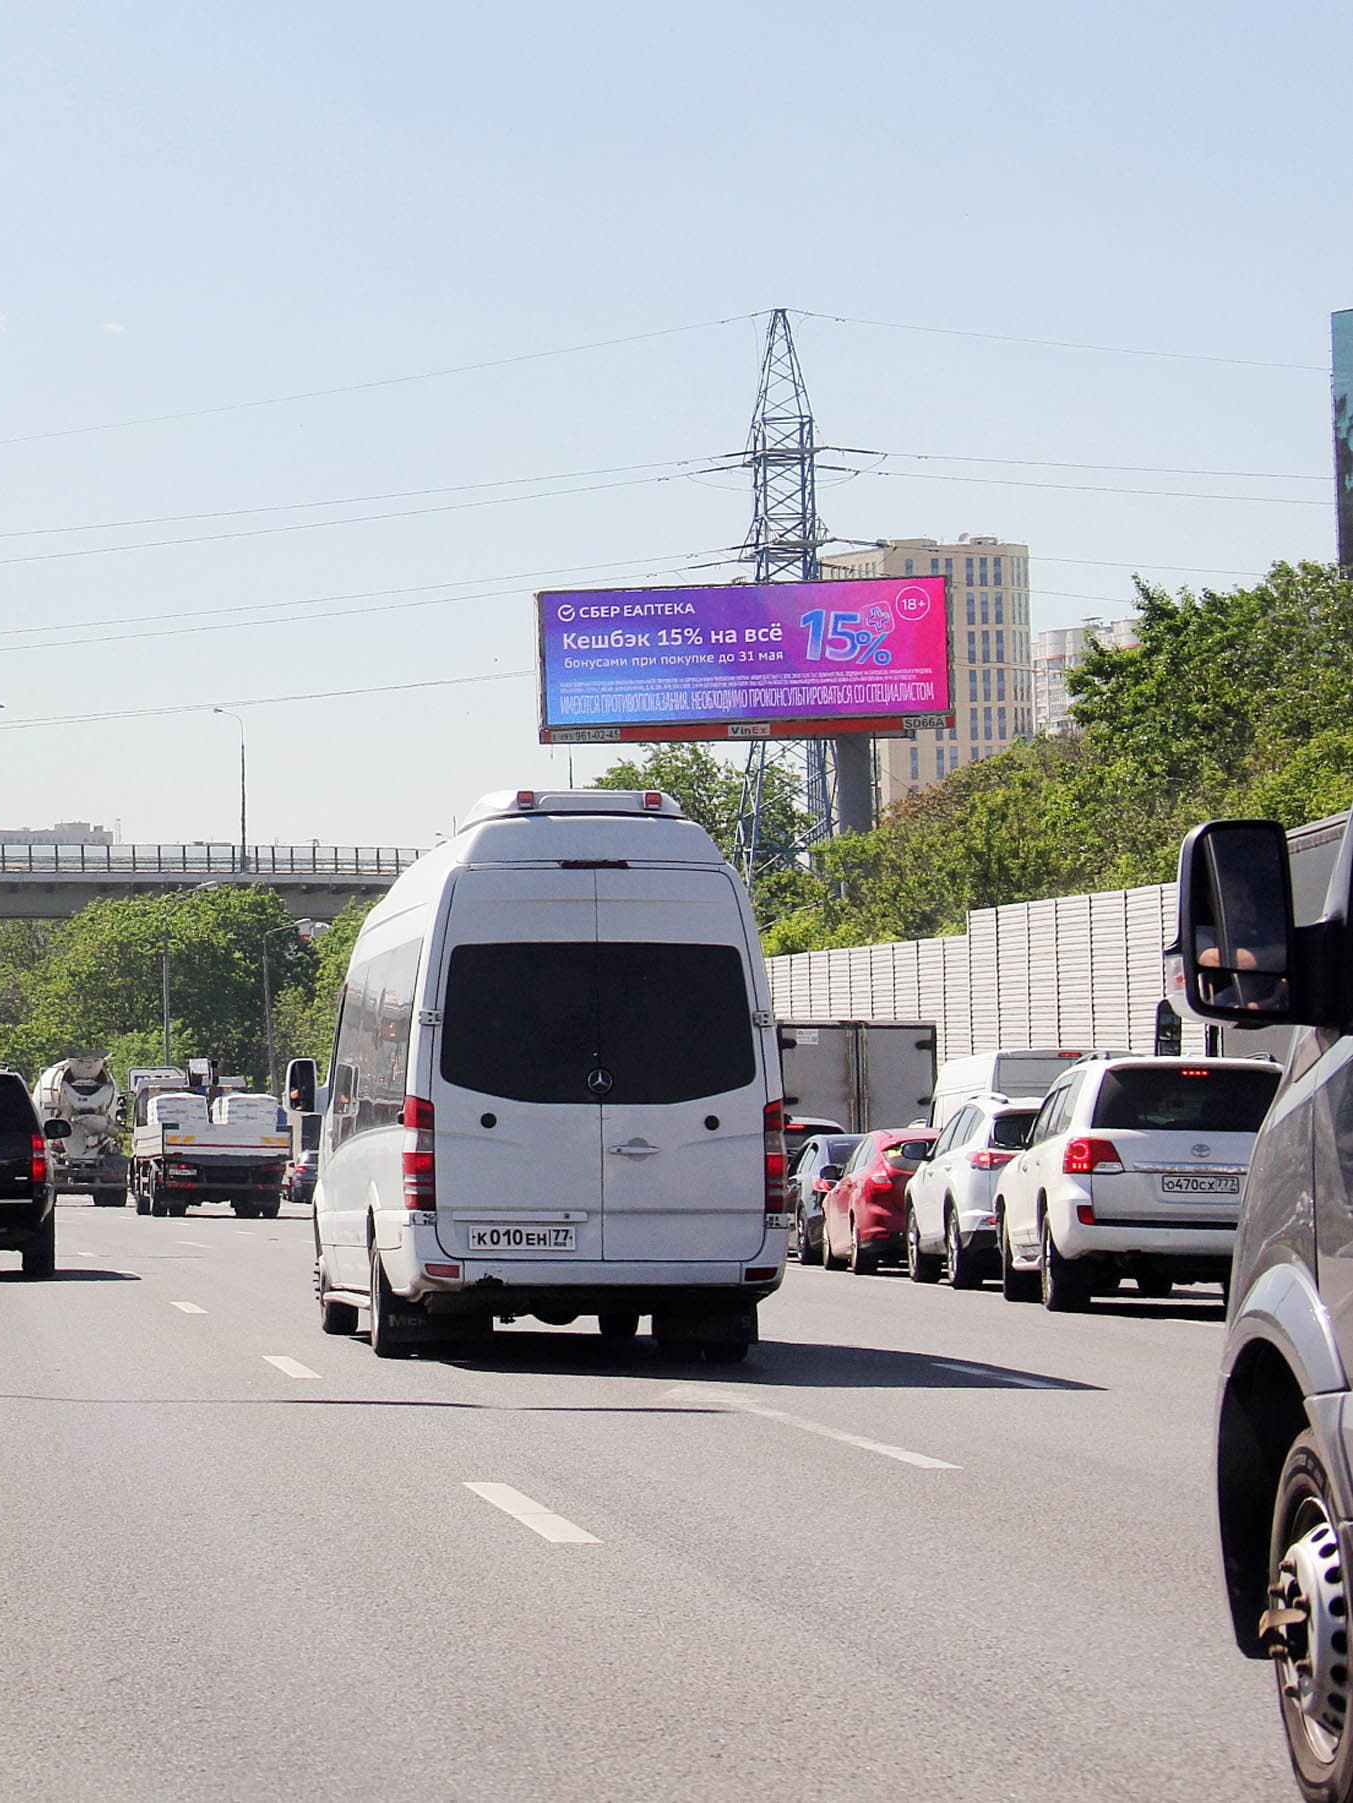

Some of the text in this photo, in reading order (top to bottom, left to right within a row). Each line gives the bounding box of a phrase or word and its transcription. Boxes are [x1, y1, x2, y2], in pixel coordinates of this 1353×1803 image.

[579, 603, 696, 619] СБЕР ЕАПТЕКА
[902, 598, 926, 611] 18+
[562, 623, 783, 650] Кешбэк 15% на всё
[800, 609, 892, 665] 15%
[564, 651, 783, 669] бонусами при покупке до 31 мая
[560, 695, 599, 715] ИМЕЮТСЯ
[692, 688, 747, 712] НЕОБХОДИМО
[749, 684, 853, 708] ПРОКОНСУЛЬТИРОВАТЬСЯ
[854, 684, 865, 703] СО
[867, 682, 935, 706] СПЕЦИАЛИСТОМ
[904, 717, 945, 729] SD66A
[552, 1229, 569, 1242] 77
